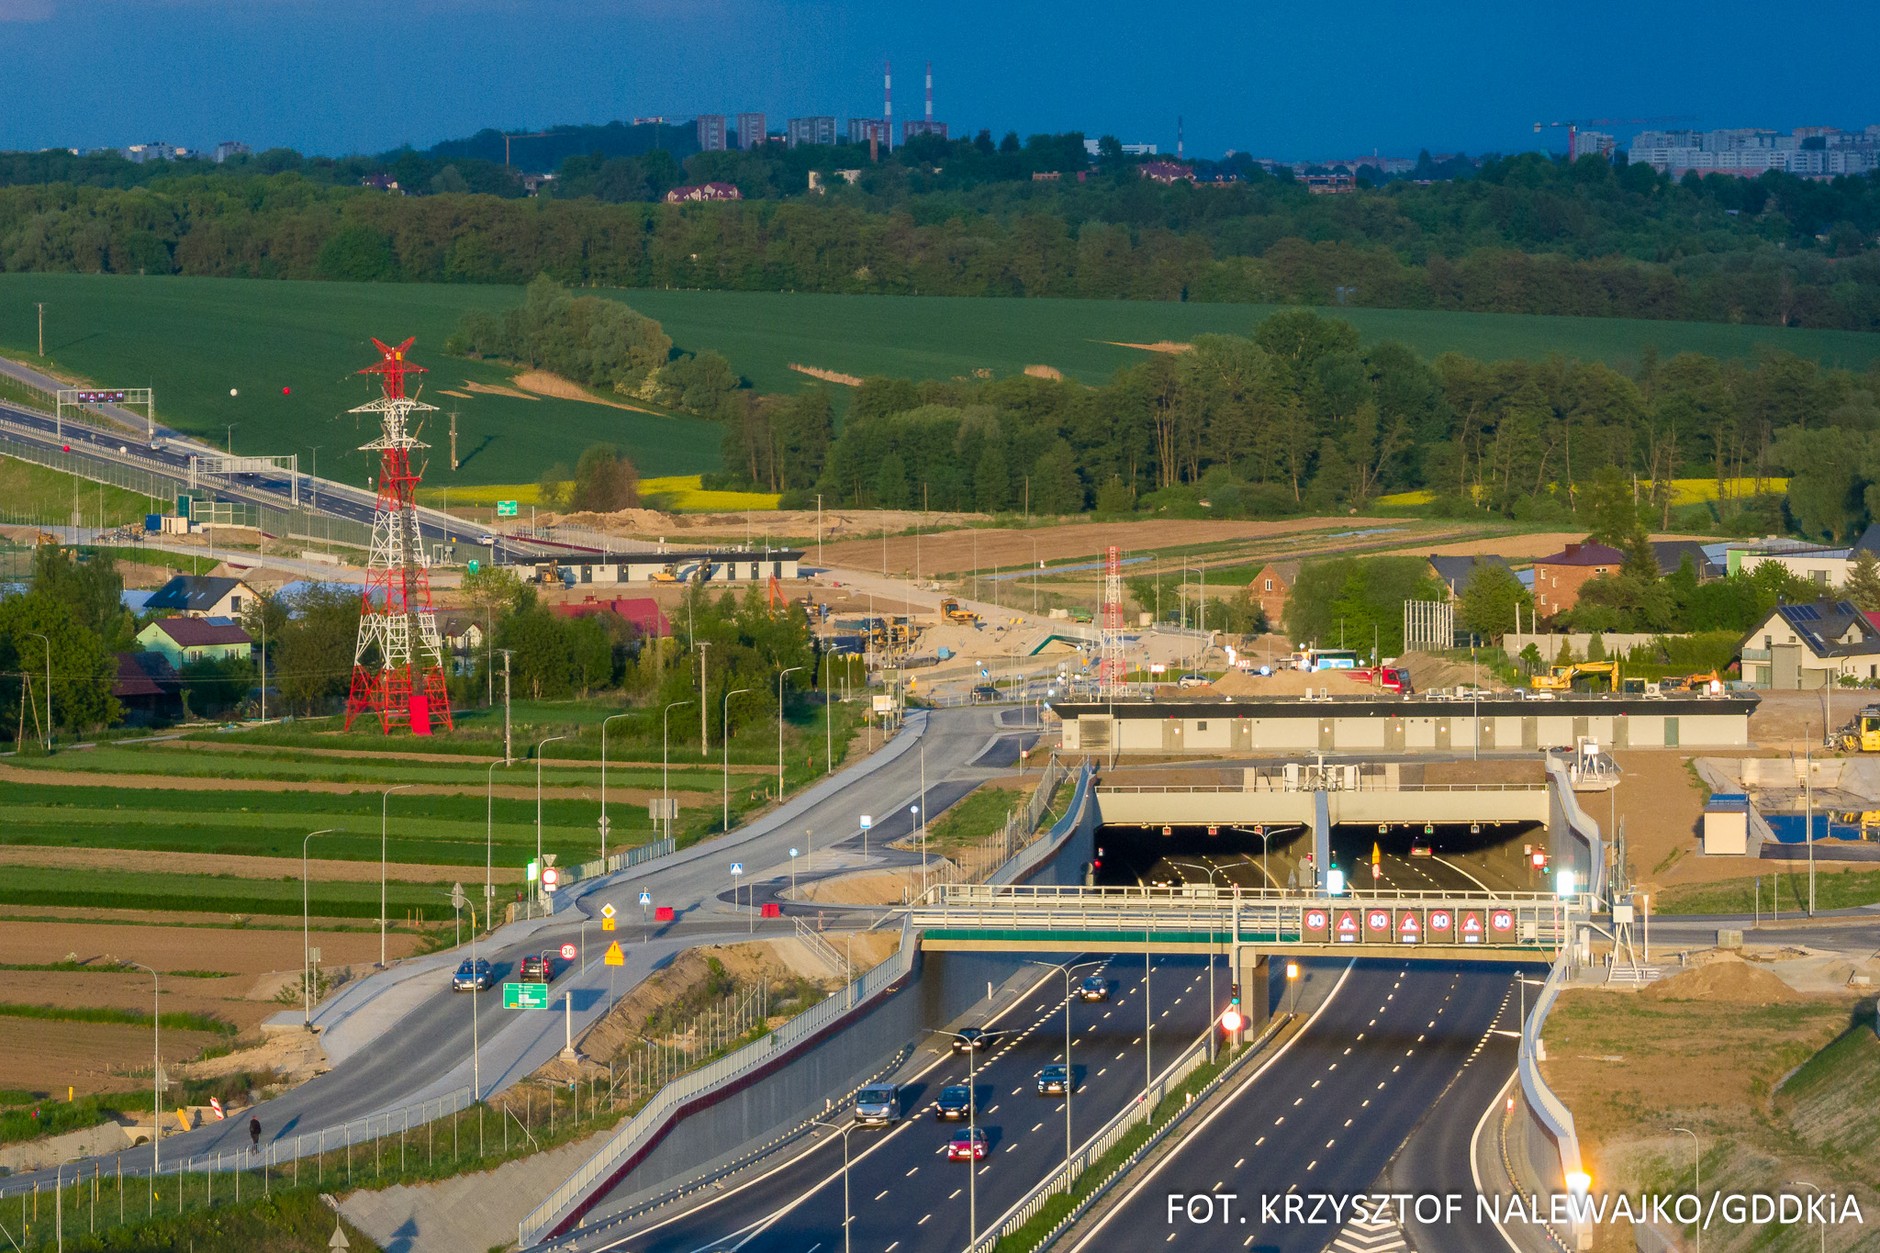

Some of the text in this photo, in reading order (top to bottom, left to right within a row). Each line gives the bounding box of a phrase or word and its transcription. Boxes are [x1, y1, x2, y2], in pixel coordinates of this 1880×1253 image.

[1308, 914, 1324, 927] 80
[1370, 914, 1386, 927] 80
[1432, 914, 1448, 927] 80
[1494, 915, 1510, 927] 80
[563, 947, 574, 956] 30
